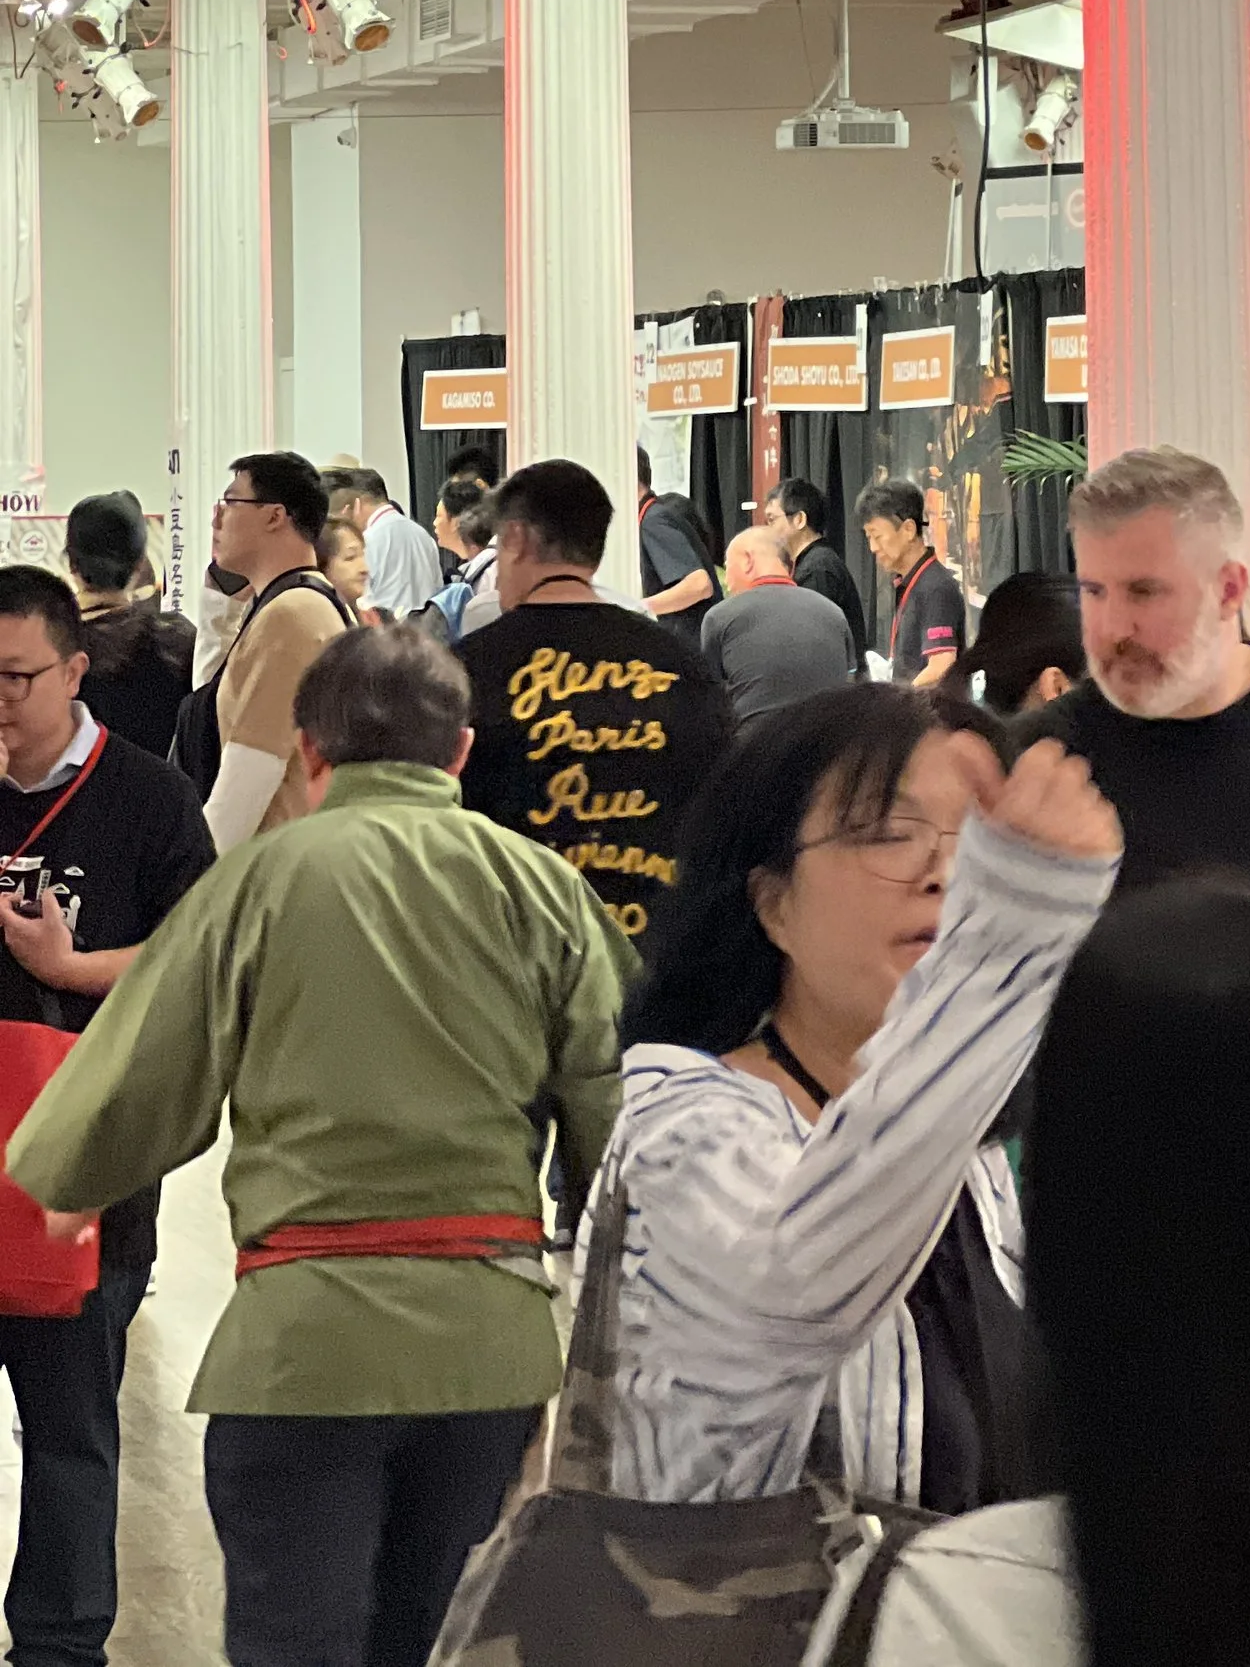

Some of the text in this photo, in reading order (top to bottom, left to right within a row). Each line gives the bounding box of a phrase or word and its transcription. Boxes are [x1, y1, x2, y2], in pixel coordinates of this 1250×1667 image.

[801, 365, 827, 386] SHOYU
[482, 390, 496, 408] CO.
[526, 710, 667, 761] Paris
[527, 763, 660, 825] Rue
